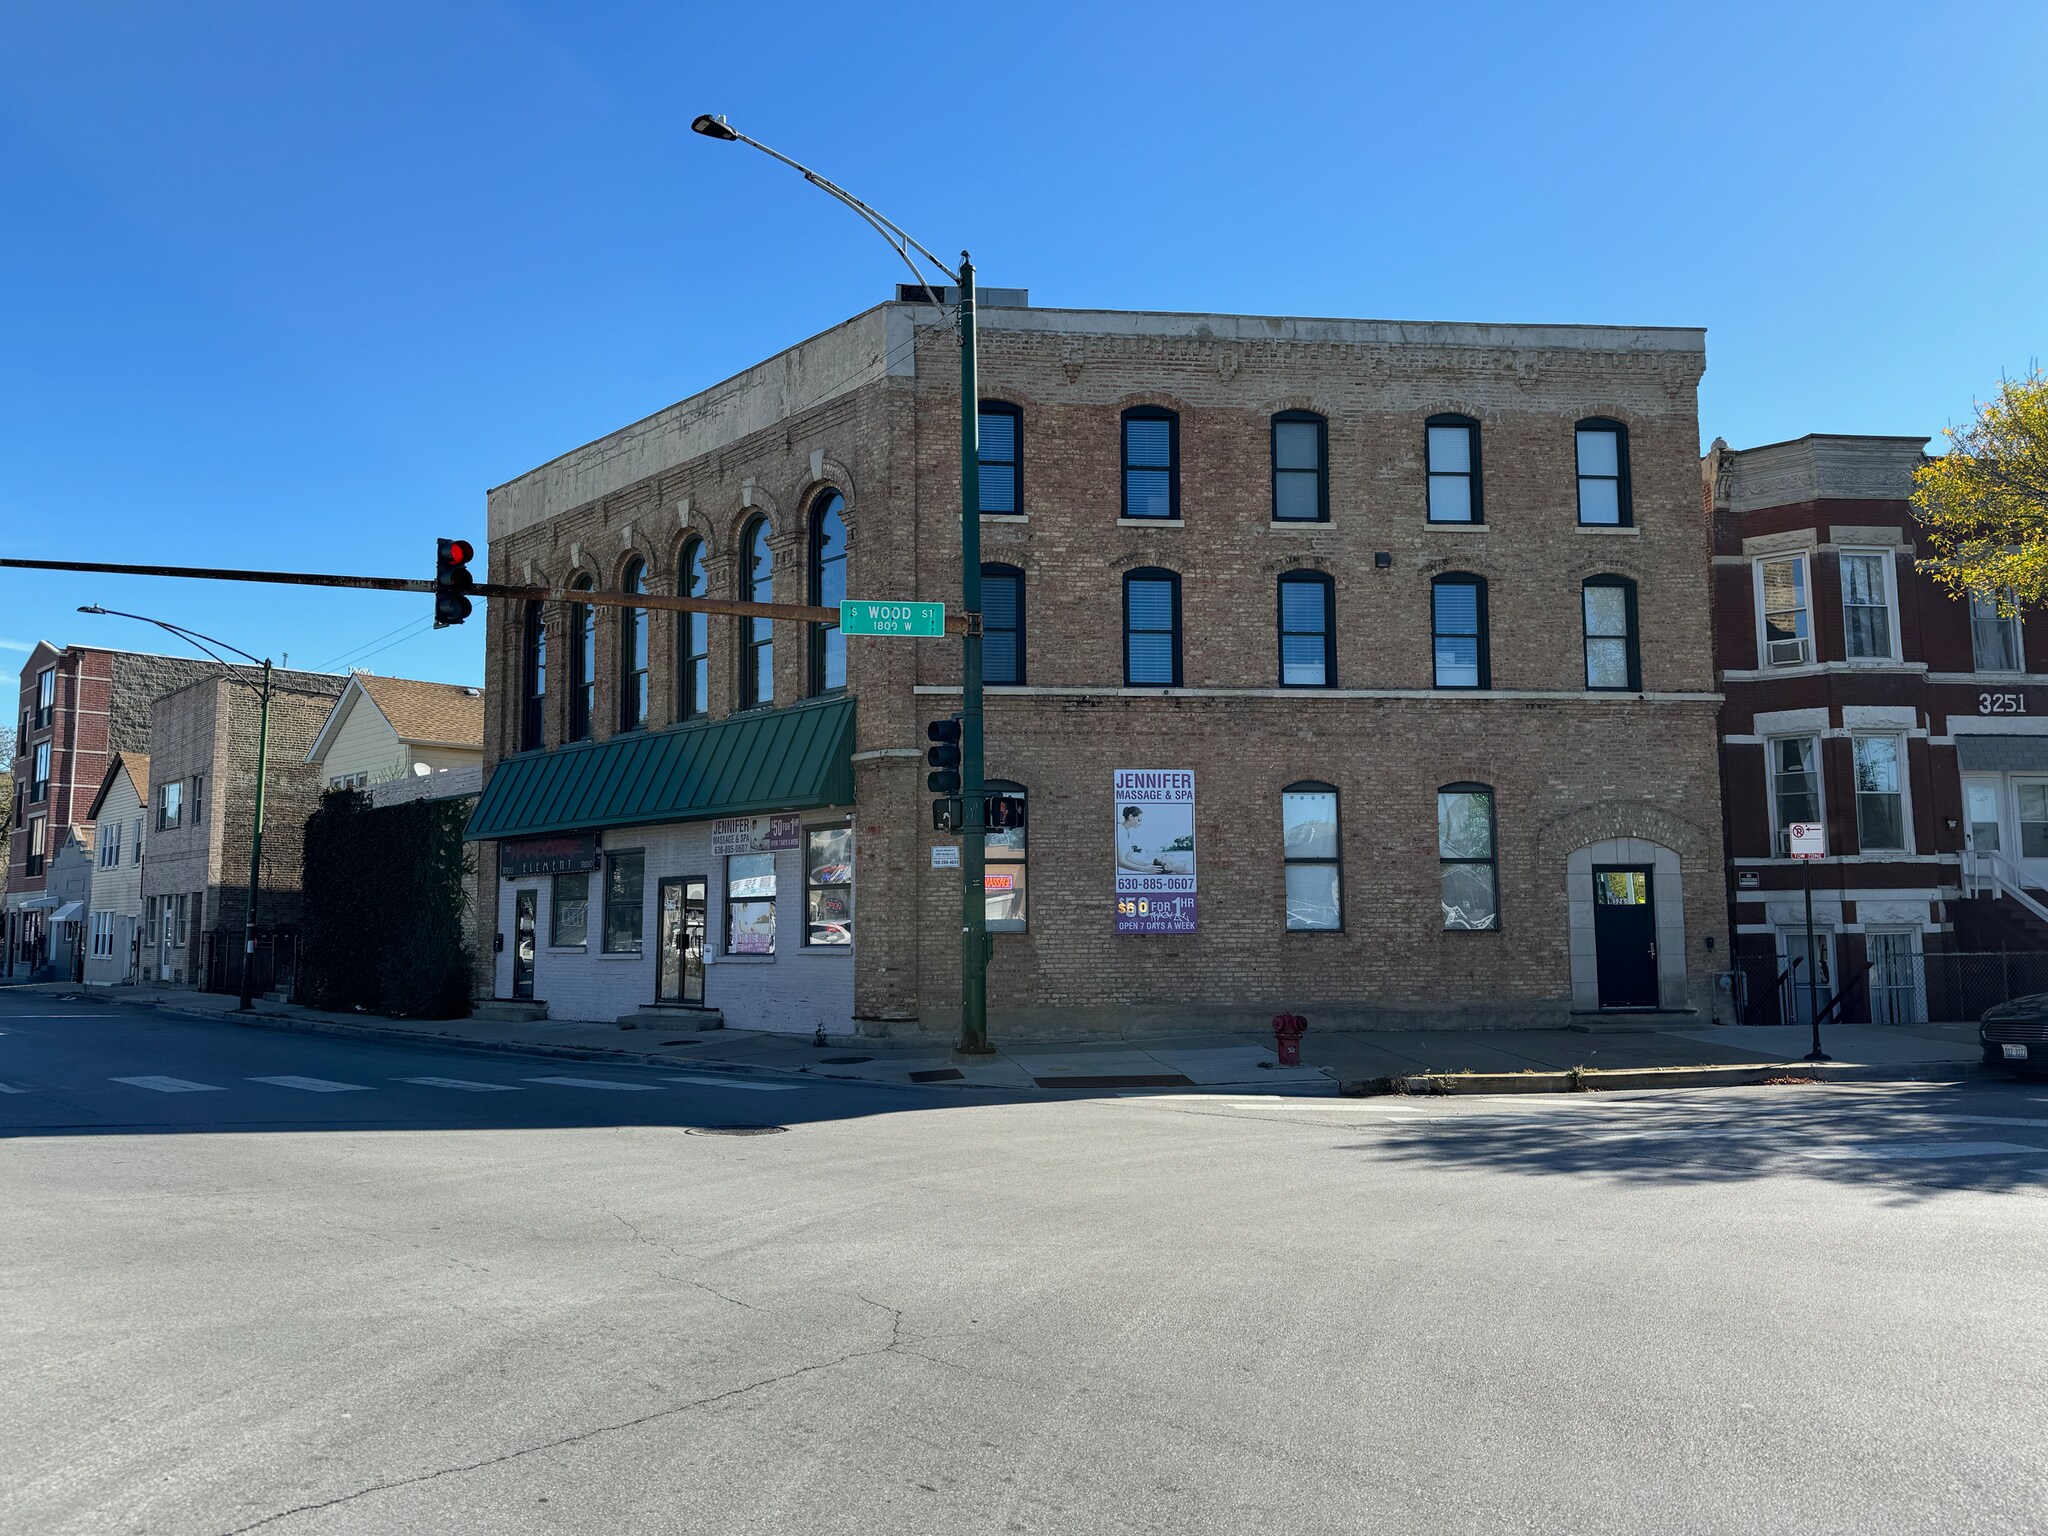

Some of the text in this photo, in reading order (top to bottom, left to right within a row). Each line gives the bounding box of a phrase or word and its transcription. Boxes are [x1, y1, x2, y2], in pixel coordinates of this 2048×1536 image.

[851, 606, 935, 620] S WOOD ST
[873, 621, 912, 631] 1800 W
[1979, 692, 2027, 714] 3251
[1116, 773, 1192, 789] JENNIFER
[1116, 790, 1193, 800] MASSAGE & SPA
[713, 818, 750, 835] JENNIFER
[783, 821, 791, 831] FOR
[713, 834, 735, 845] MASSAGE
[740, 833, 749, 843] SPA
[523, 859, 571, 873] ELEMENT
[1118, 878, 1194, 890] 630-885-0607
[1151, 901, 1171, 912] FOR
[1119, 922, 1195, 930] OPEN 7 DAYS A WEEK
